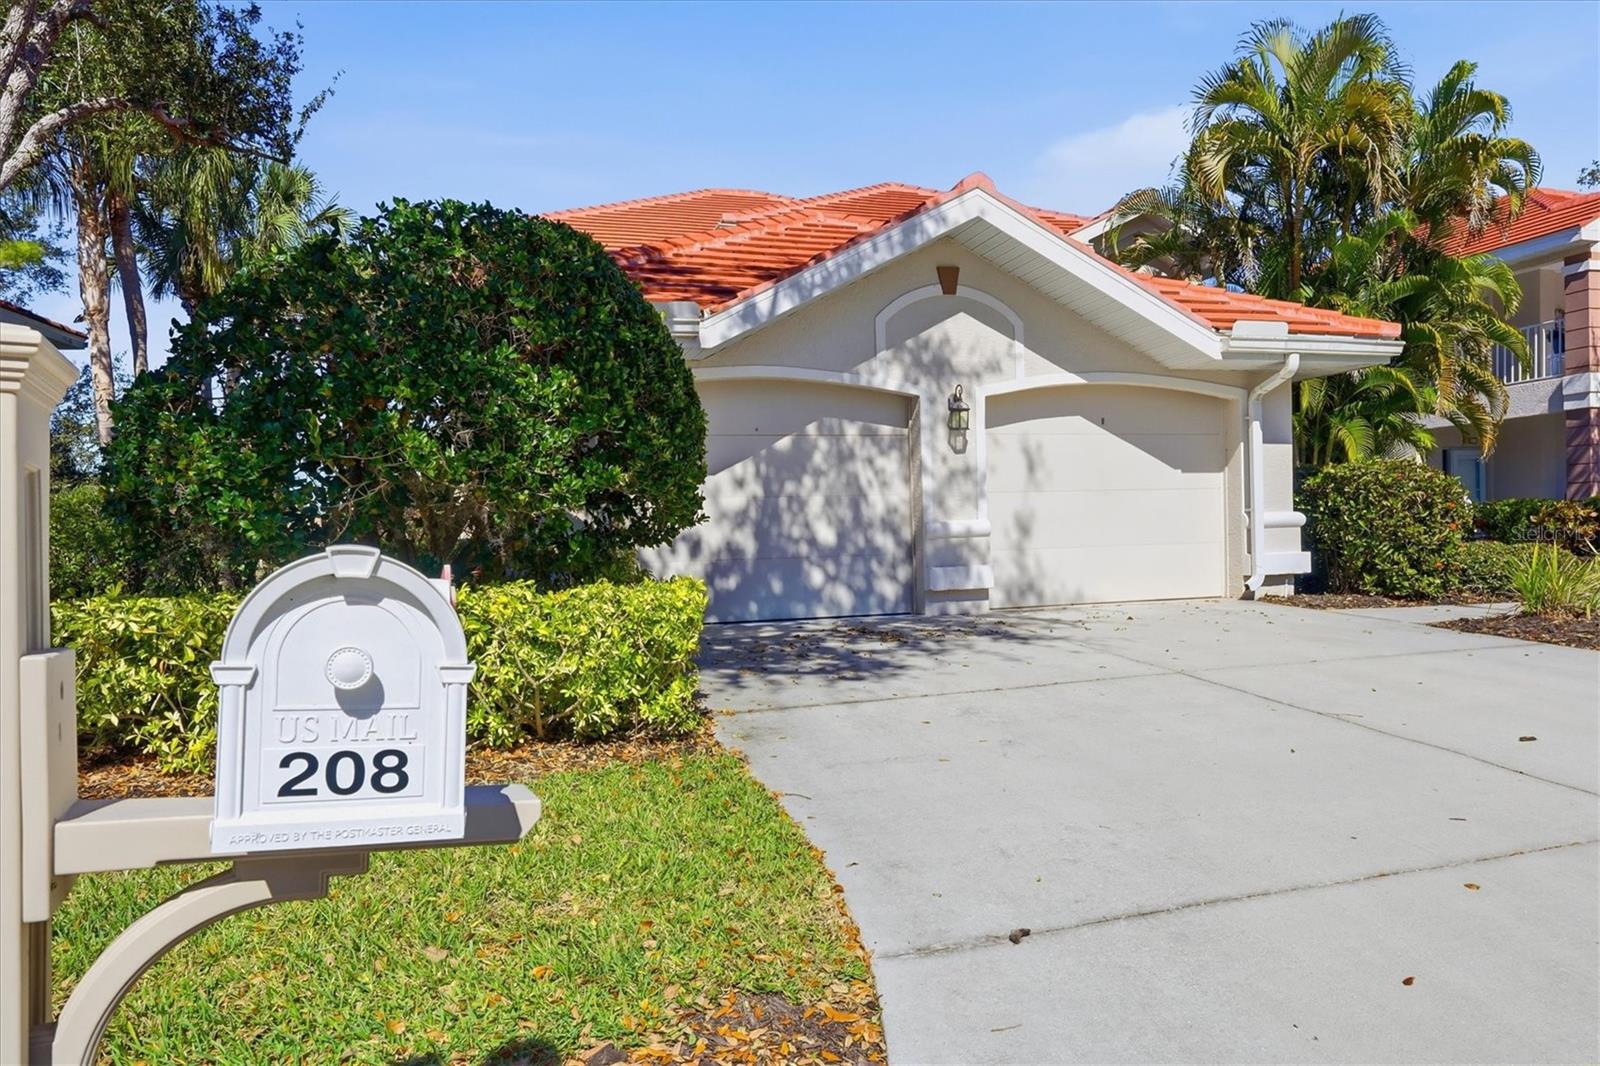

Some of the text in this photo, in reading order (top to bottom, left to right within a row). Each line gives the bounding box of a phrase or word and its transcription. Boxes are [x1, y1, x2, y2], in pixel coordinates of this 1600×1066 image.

[275, 714, 418, 744] US MAIL
[277, 749, 409, 797] 208
[229, 822, 452, 845] APPROVED BY THE POSTMASTER GENERAL
